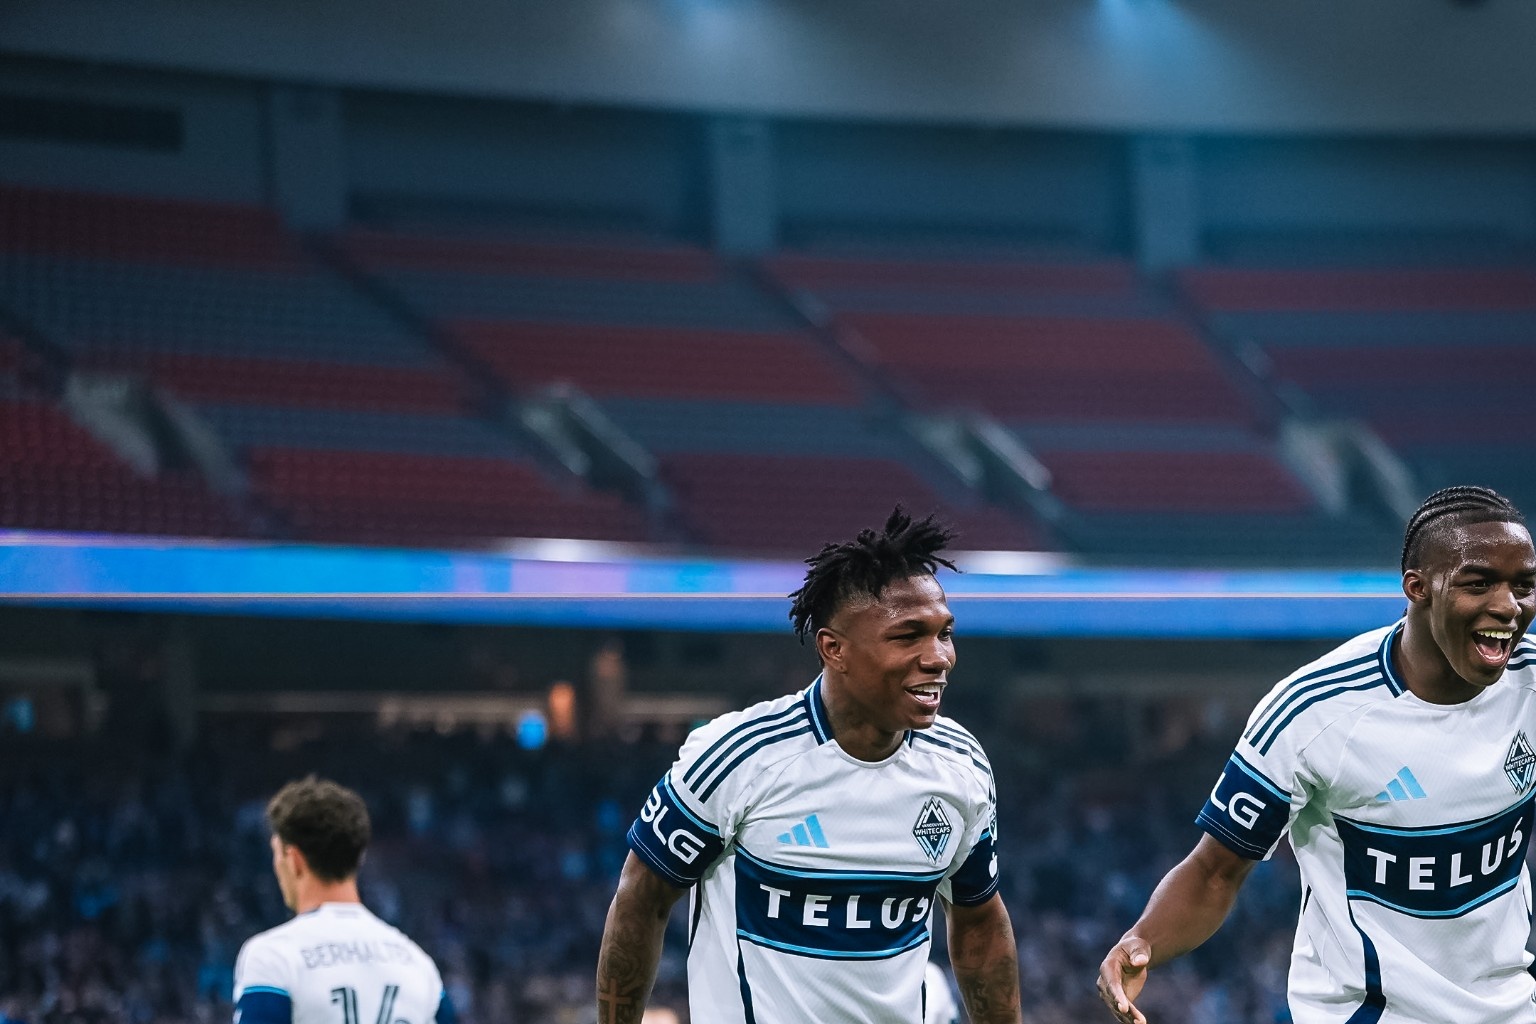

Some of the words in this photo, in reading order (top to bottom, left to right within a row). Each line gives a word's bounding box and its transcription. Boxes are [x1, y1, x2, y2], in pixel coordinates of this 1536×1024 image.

[914, 826, 951, 837] WHITECAPS
[930, 834, 938, 842] FC
[1366, 816, 1523, 891] TELUS
[759, 883, 930, 930] TELUS
